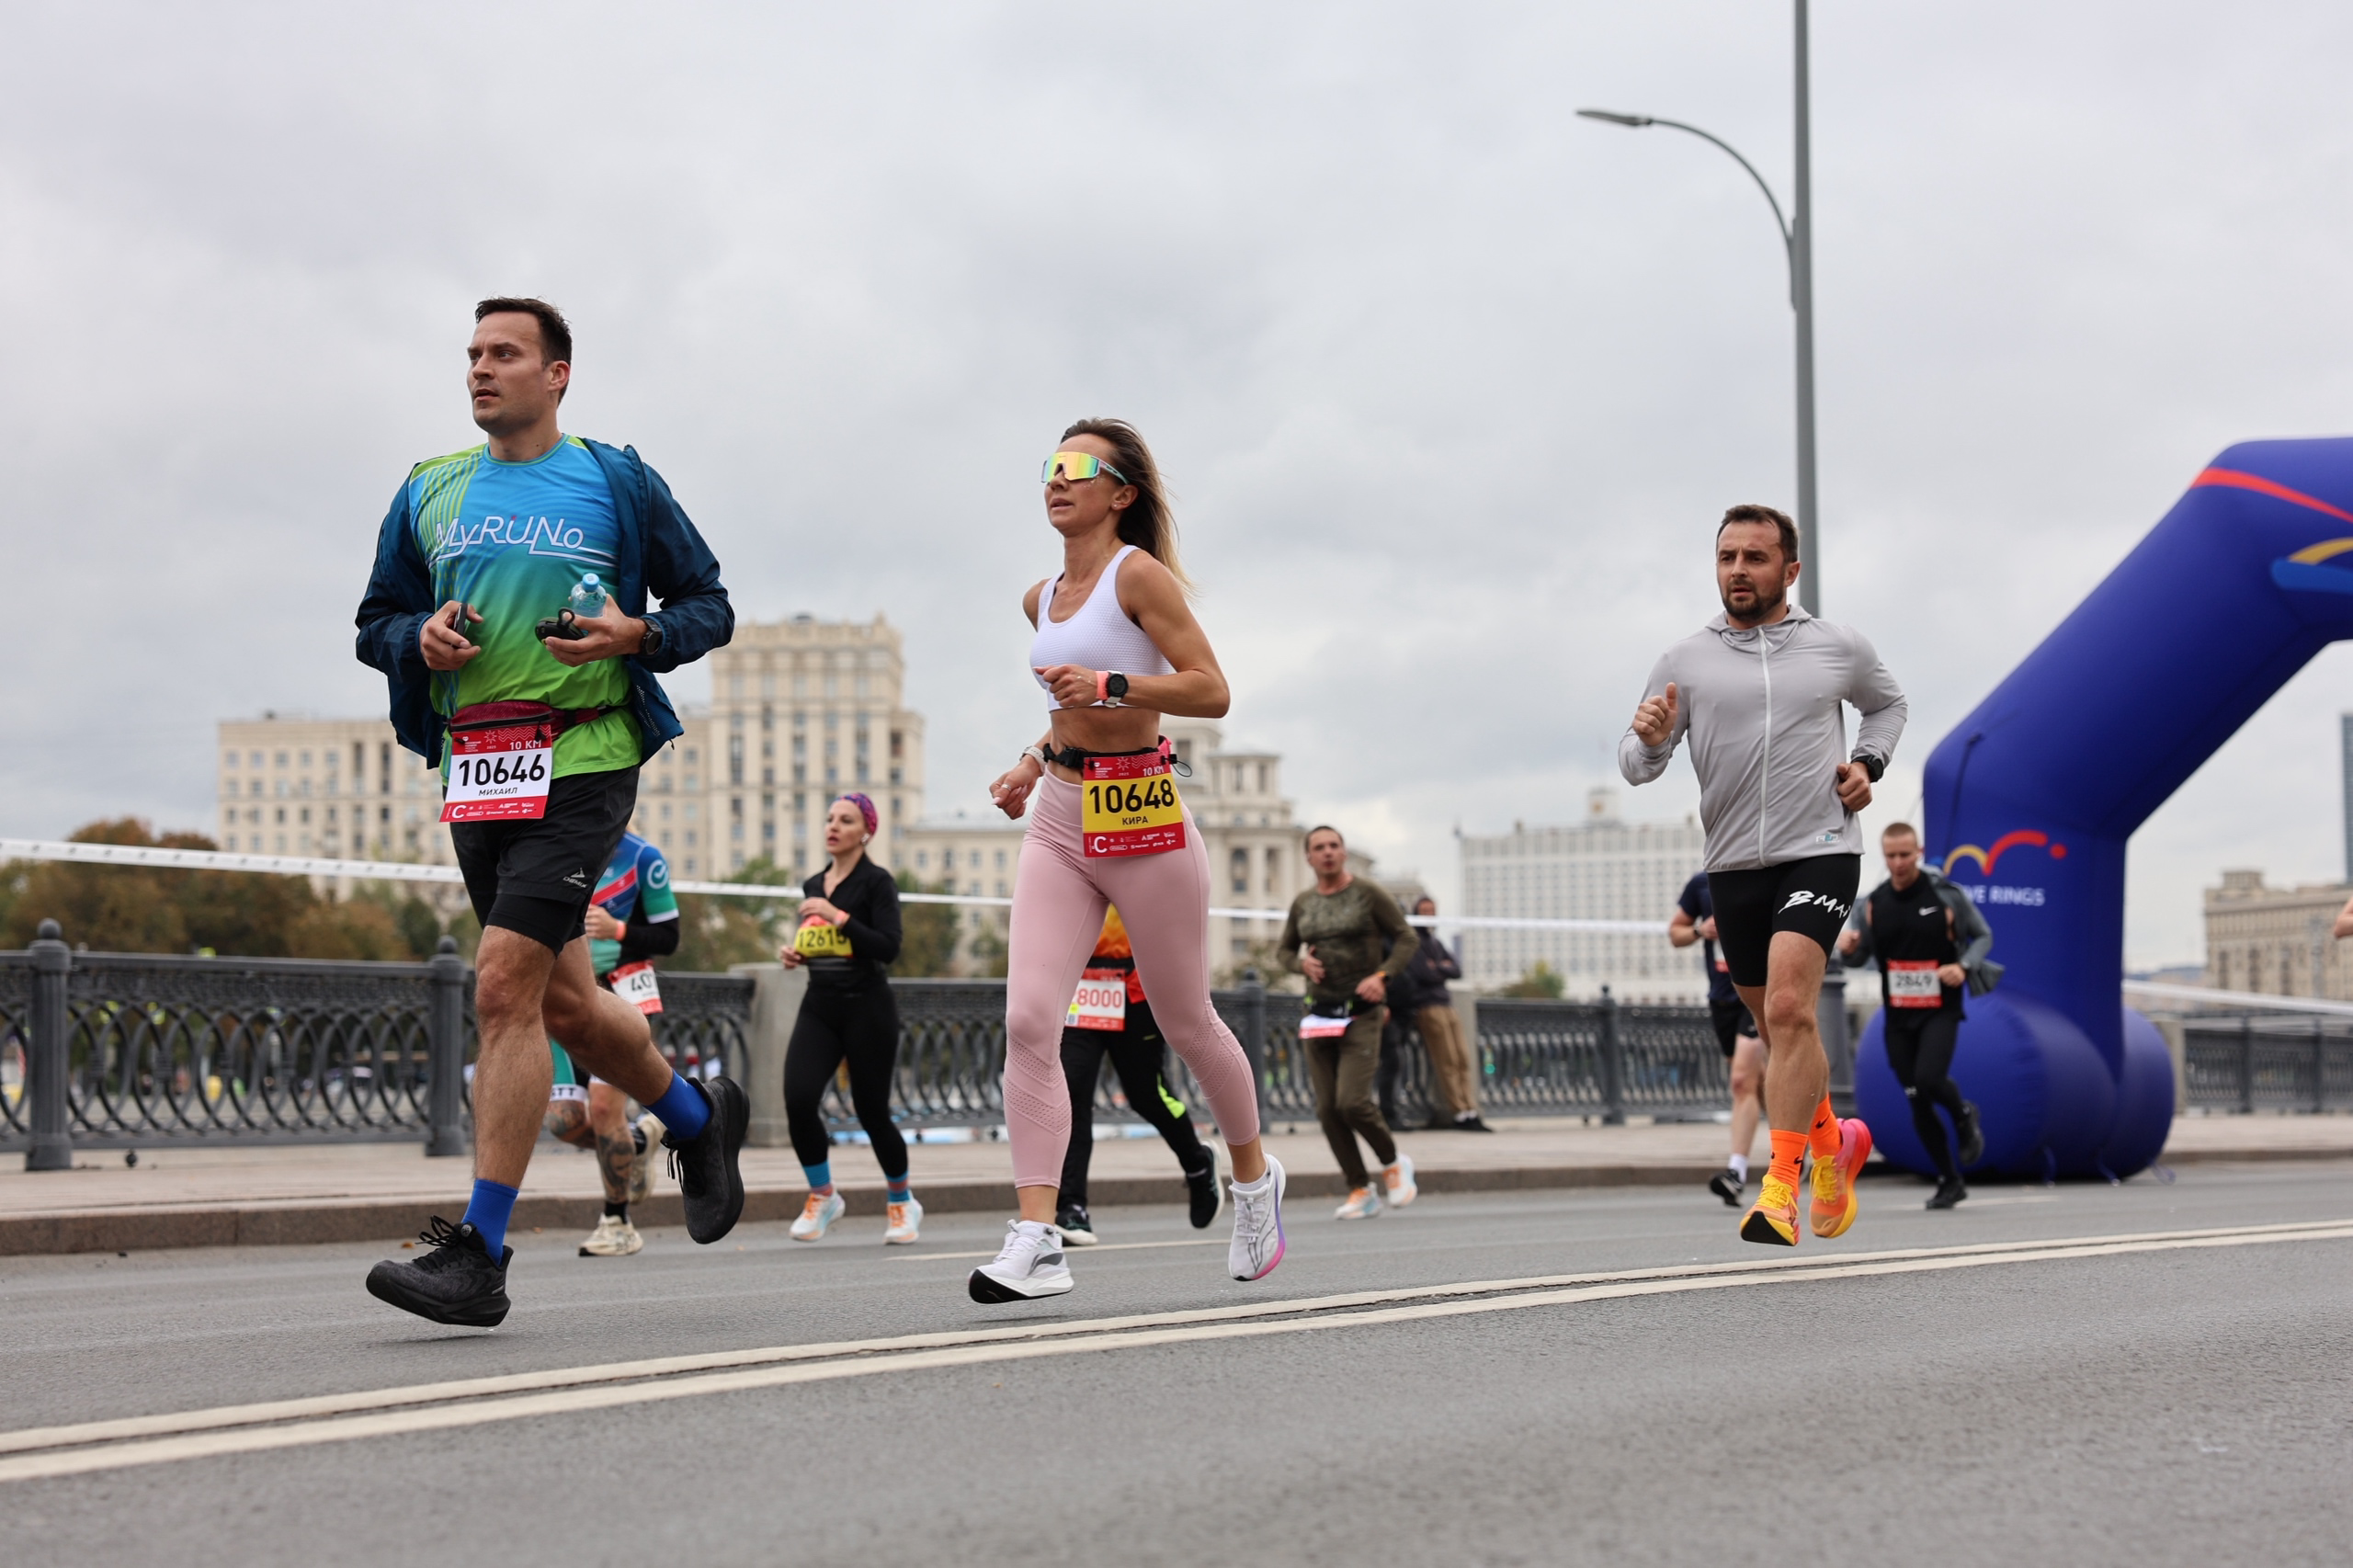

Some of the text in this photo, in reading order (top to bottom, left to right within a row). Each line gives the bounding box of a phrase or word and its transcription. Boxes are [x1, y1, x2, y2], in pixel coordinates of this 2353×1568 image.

[509, 742, 522, 751] 10
[459, 754, 545, 787] 10646
[1142, 767, 1154, 777] 10
[478, 787, 518, 796] МИХАИЛ
[1089, 778, 1175, 814] 10648
[1121, 815, 1149, 825] КИРА
[1988, 885, 2046, 907] RINGS
[631, 971, 653, 992] 40
